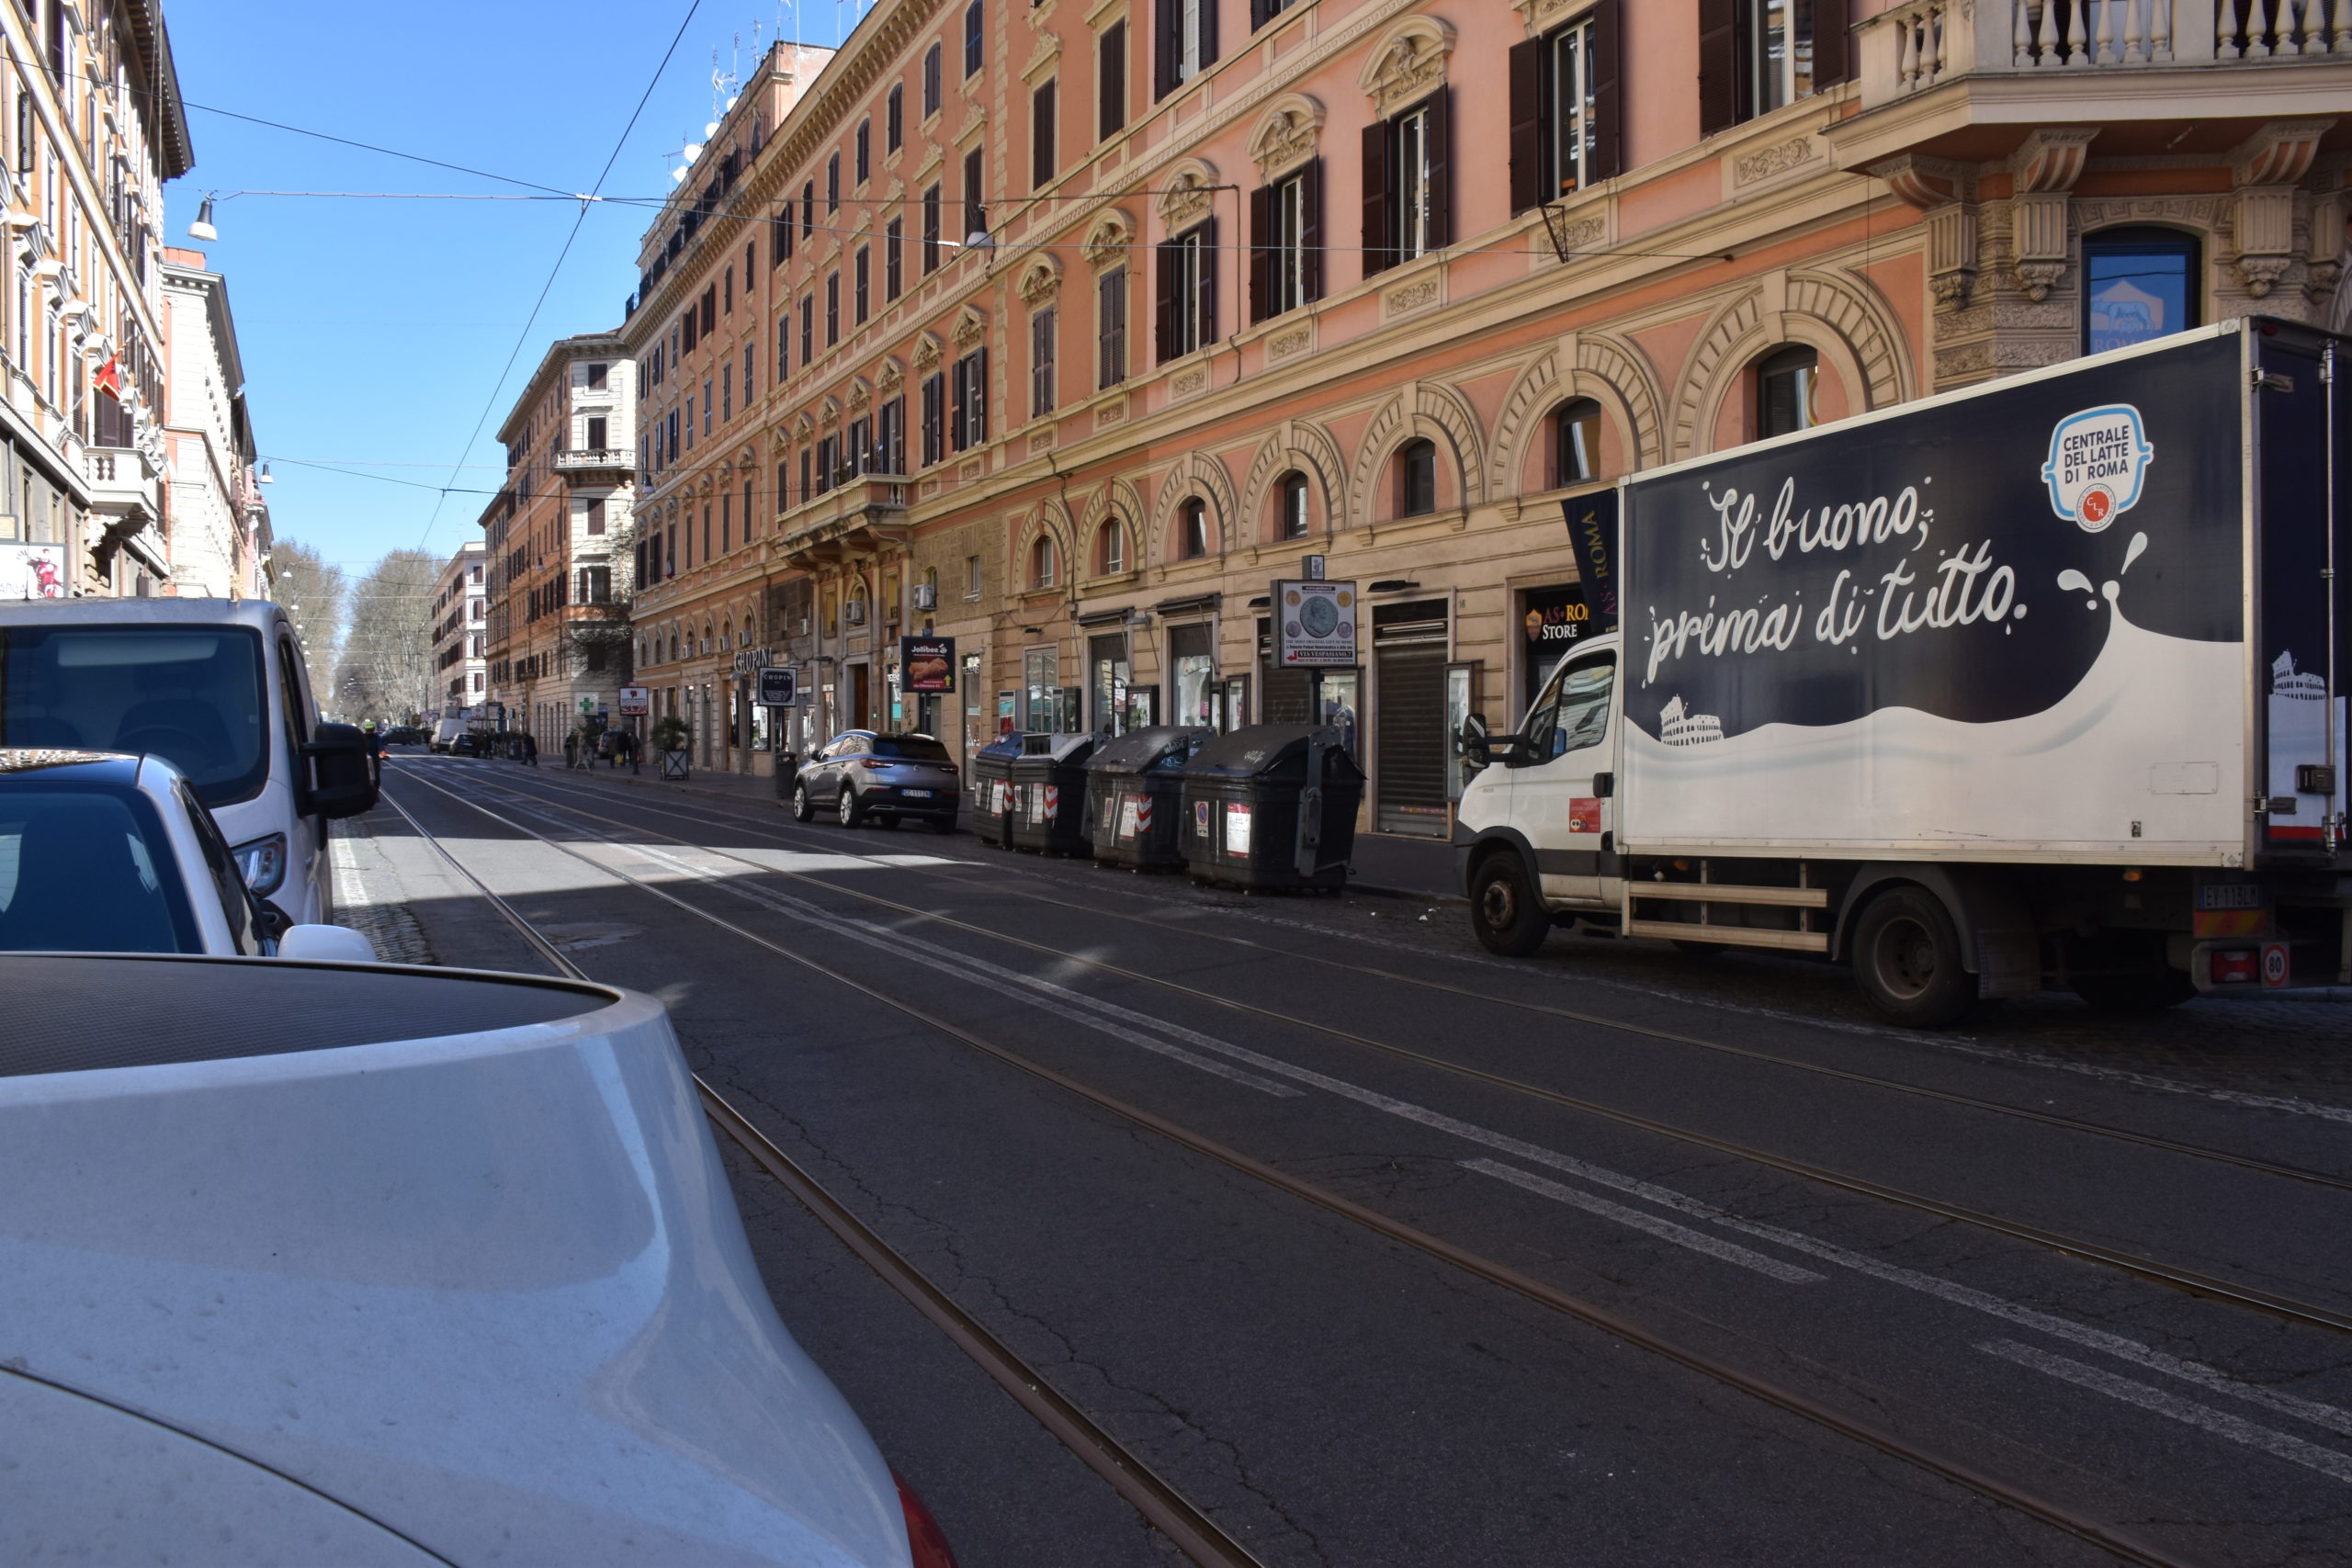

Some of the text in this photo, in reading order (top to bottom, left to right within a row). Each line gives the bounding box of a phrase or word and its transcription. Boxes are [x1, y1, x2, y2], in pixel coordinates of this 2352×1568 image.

[2064, 424, 2130, 452] CENTRALE
[2064, 442, 2129, 468] DEL LATTE
[2064, 458, 2129, 484] DI ROMA
[1581, 510, 1609, 580] ROMA
[1647, 538, 2028, 683] prima di tutto.
[1542, 624, 1577, 640] STORE
[735, 647, 772, 672] CHOPIN
[2268, 956, 2282, 974] 80
